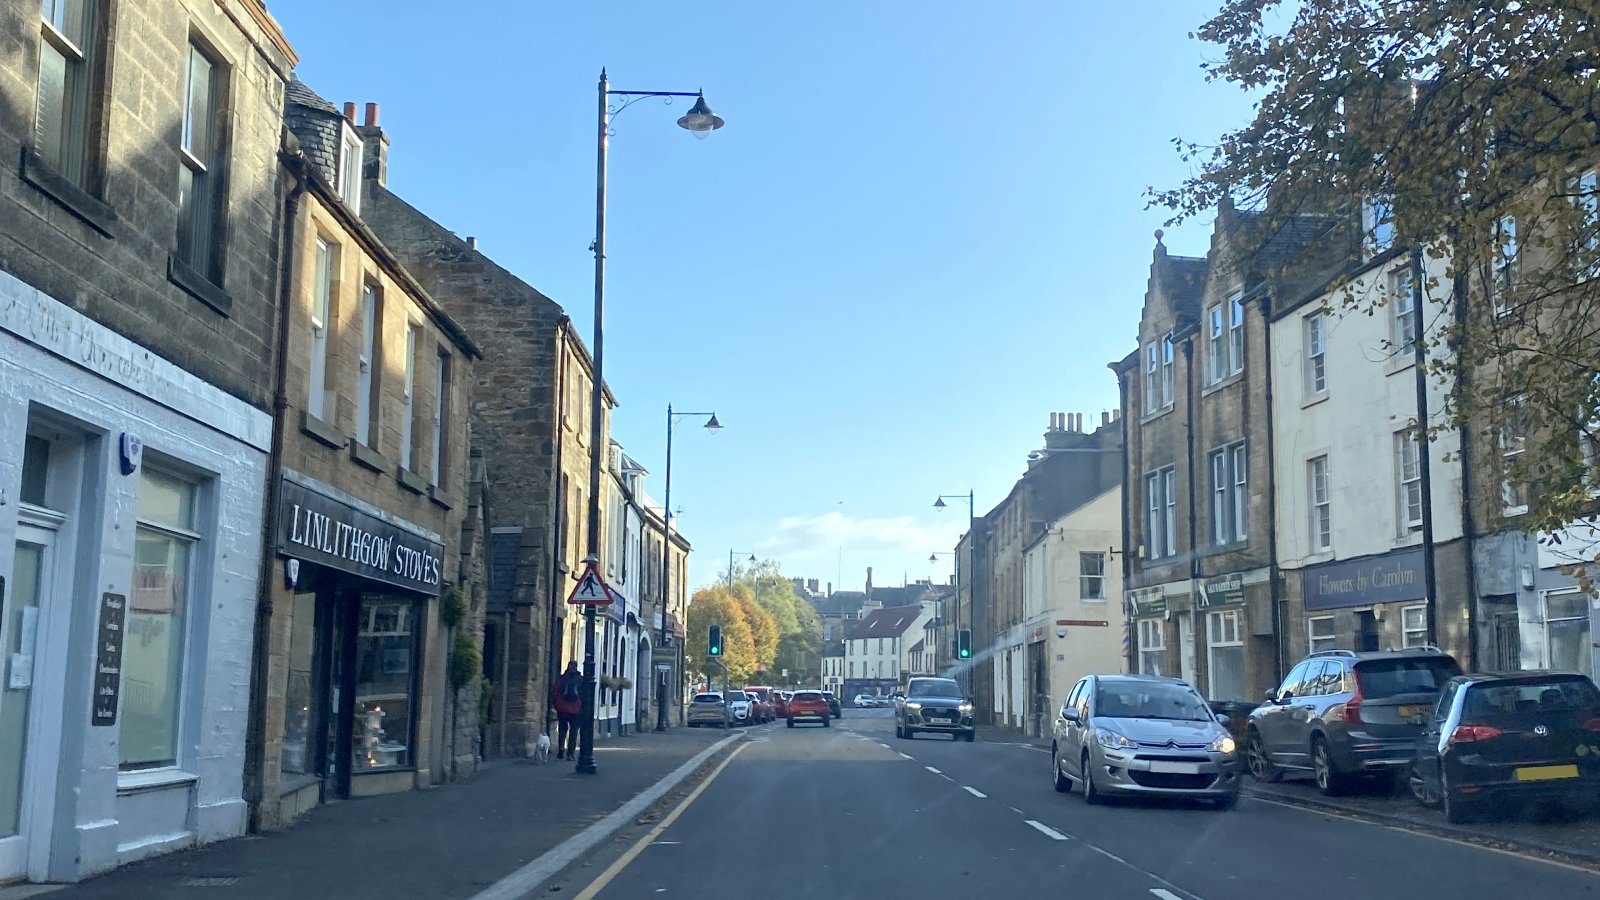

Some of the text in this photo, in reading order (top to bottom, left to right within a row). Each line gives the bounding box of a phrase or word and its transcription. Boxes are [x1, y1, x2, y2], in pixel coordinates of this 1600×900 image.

[291, 504, 440, 586] LINLITHGOW STOVES
[1319, 562, 1414, 596] Flowers by Carolyn
